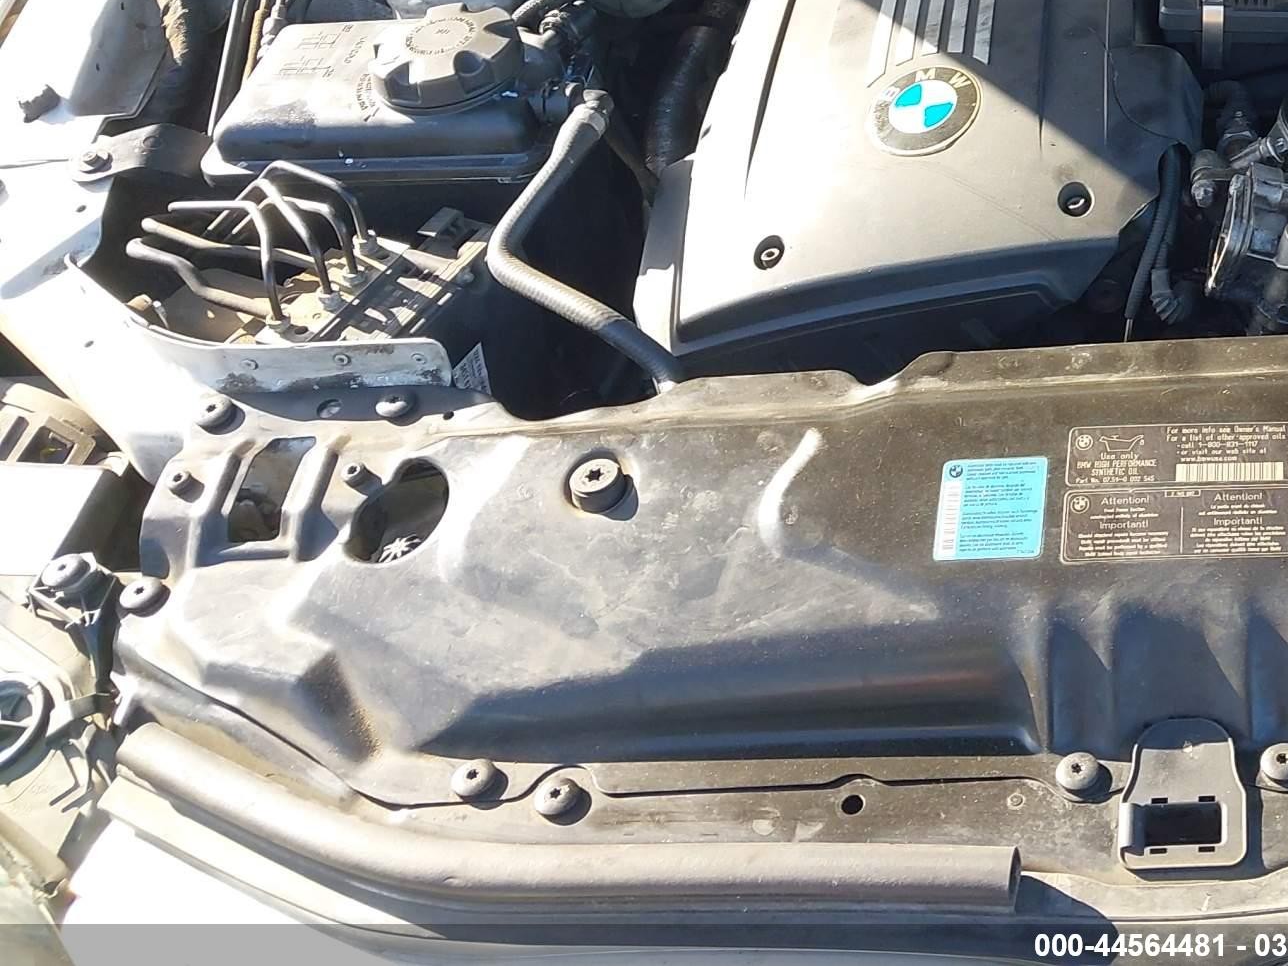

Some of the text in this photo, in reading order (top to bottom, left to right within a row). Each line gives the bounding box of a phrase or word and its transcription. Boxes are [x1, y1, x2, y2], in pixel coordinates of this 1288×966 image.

[883, 68, 972, 101] BMW
[1262, 425, 1286, 433] Manual
[1100, 451, 1139, 461] Use only
[1112, 459, 1157, 468] PERFORMANCE
[1091, 468, 1126, 476] SYNTHETIC
[1100, 495, 1150, 505] Attention!
[1214, 492, 1263, 501] Attention!
[1099, 519, 1149, 530] Important!
[1213, 516, 1263, 526] Important!
